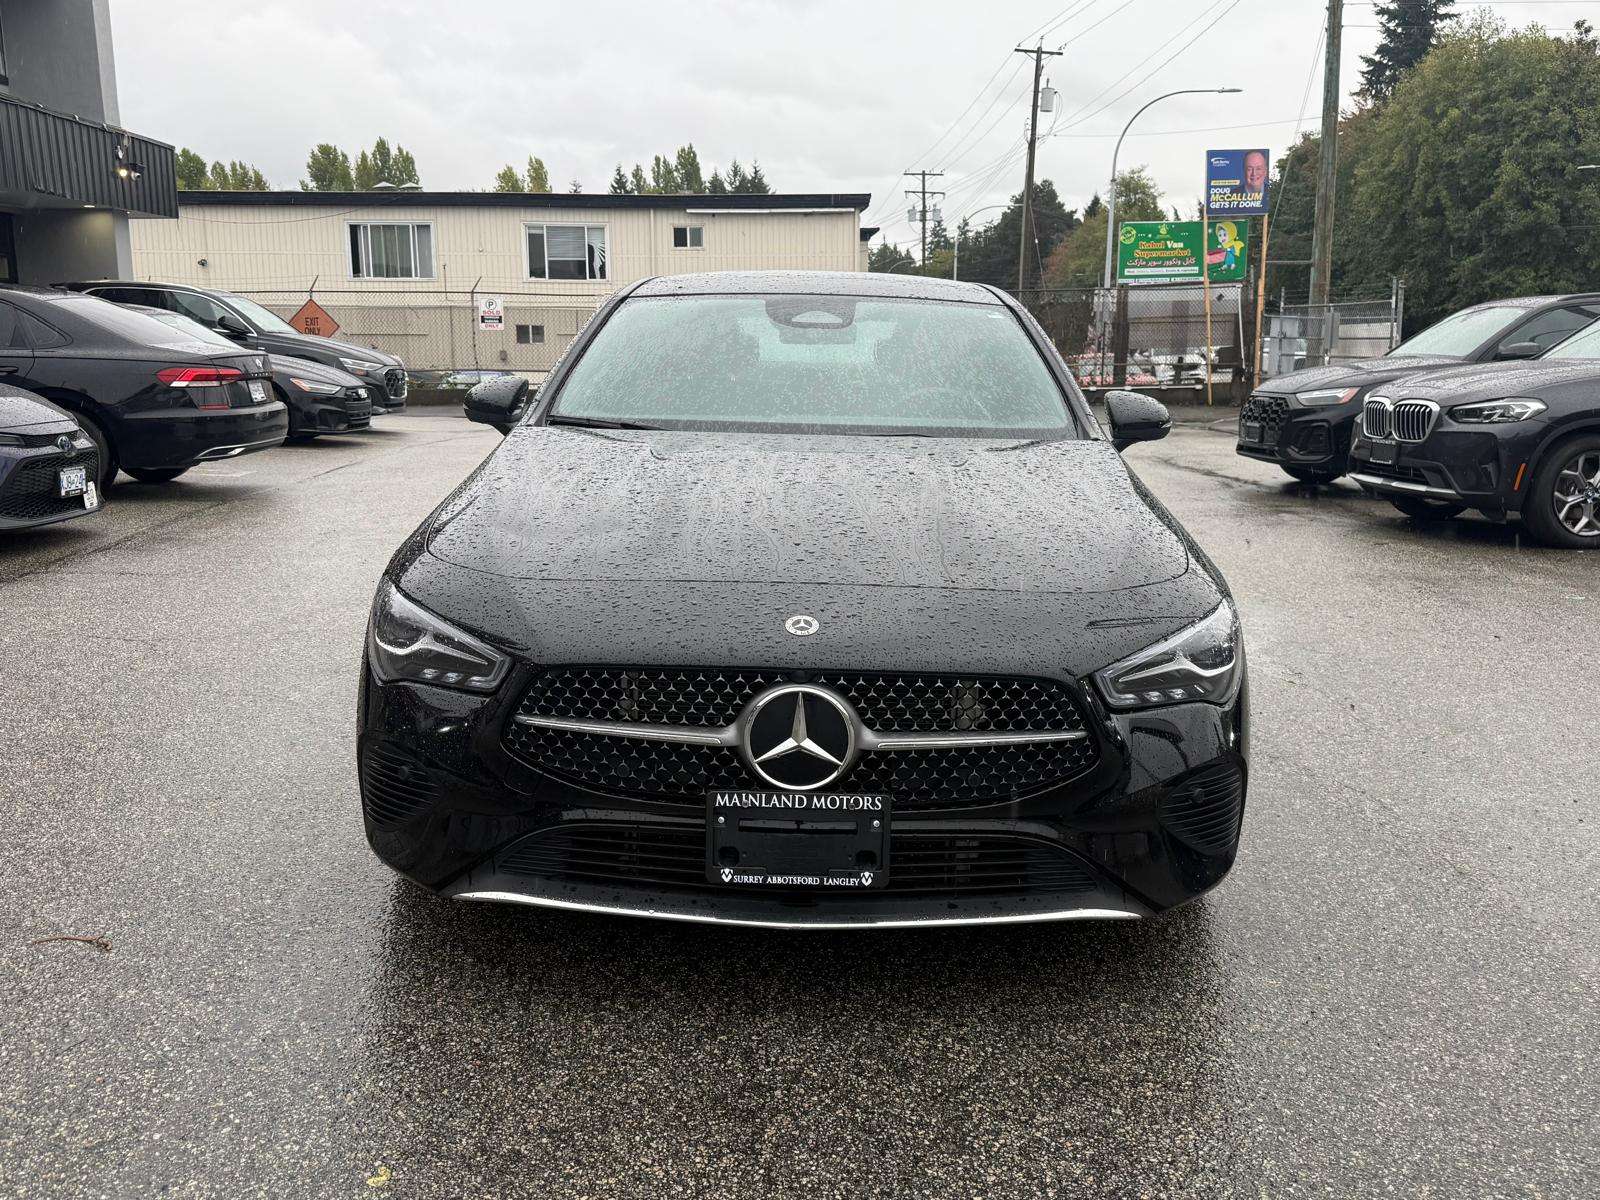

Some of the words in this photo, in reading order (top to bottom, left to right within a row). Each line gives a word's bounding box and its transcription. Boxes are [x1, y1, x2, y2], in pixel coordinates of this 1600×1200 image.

[1210, 192, 1263, 201] McCALLUM
[1210, 201, 1230, 209] GETS
[1166, 240, 1184, 248] Van
[1134, 249, 1191, 258] Supermarket
[304, 317, 319, 326] EXIT
[304, 327, 320, 335] ONLY
[715, 793, 807, 809] MAINLAND
[811, 795, 882, 810] MOTORS
[733, 875, 764, 884] SURREY
[766, 876, 820, 885] ABBOTSFORD
[823, 877, 860, 886] LANGLEY
